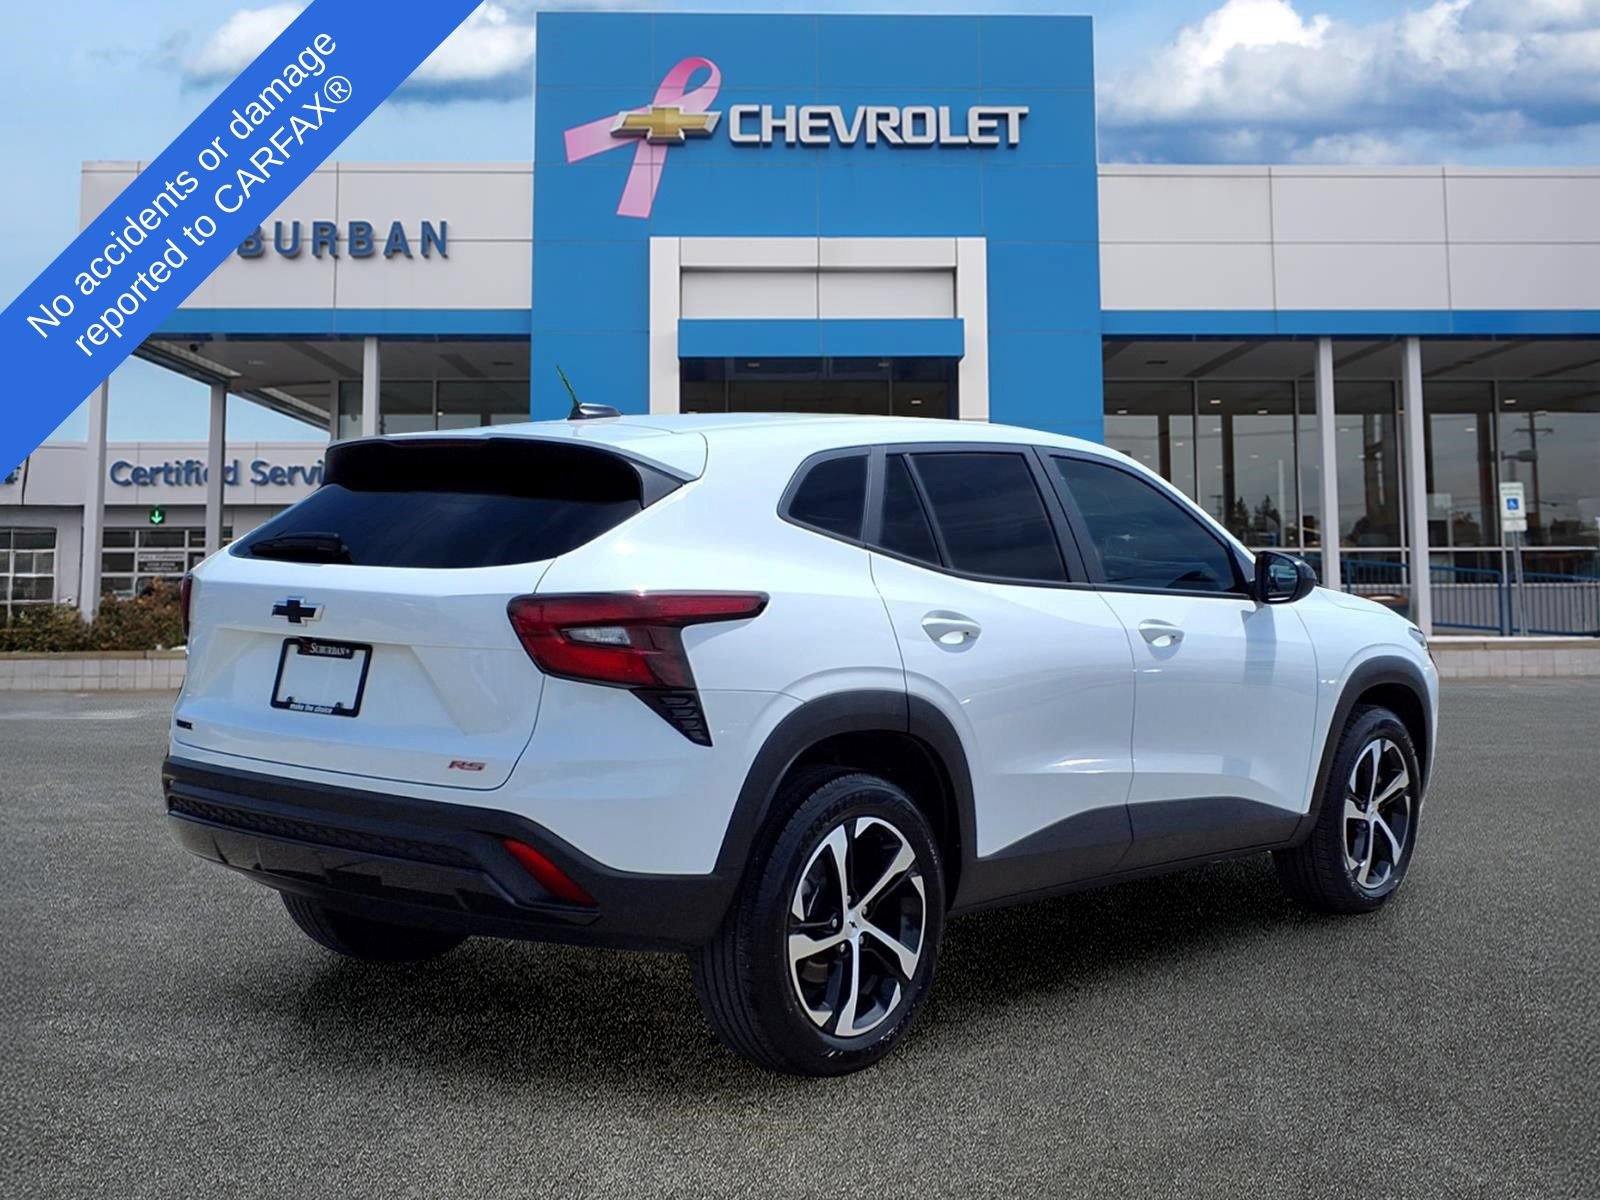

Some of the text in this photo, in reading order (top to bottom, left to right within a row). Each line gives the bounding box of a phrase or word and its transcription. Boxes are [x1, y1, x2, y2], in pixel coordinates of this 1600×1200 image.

[728, 104, 1029, 146] CHEVROLET
[110, 459, 240, 486] Certifid
[448, 760, 486, 771] RS
